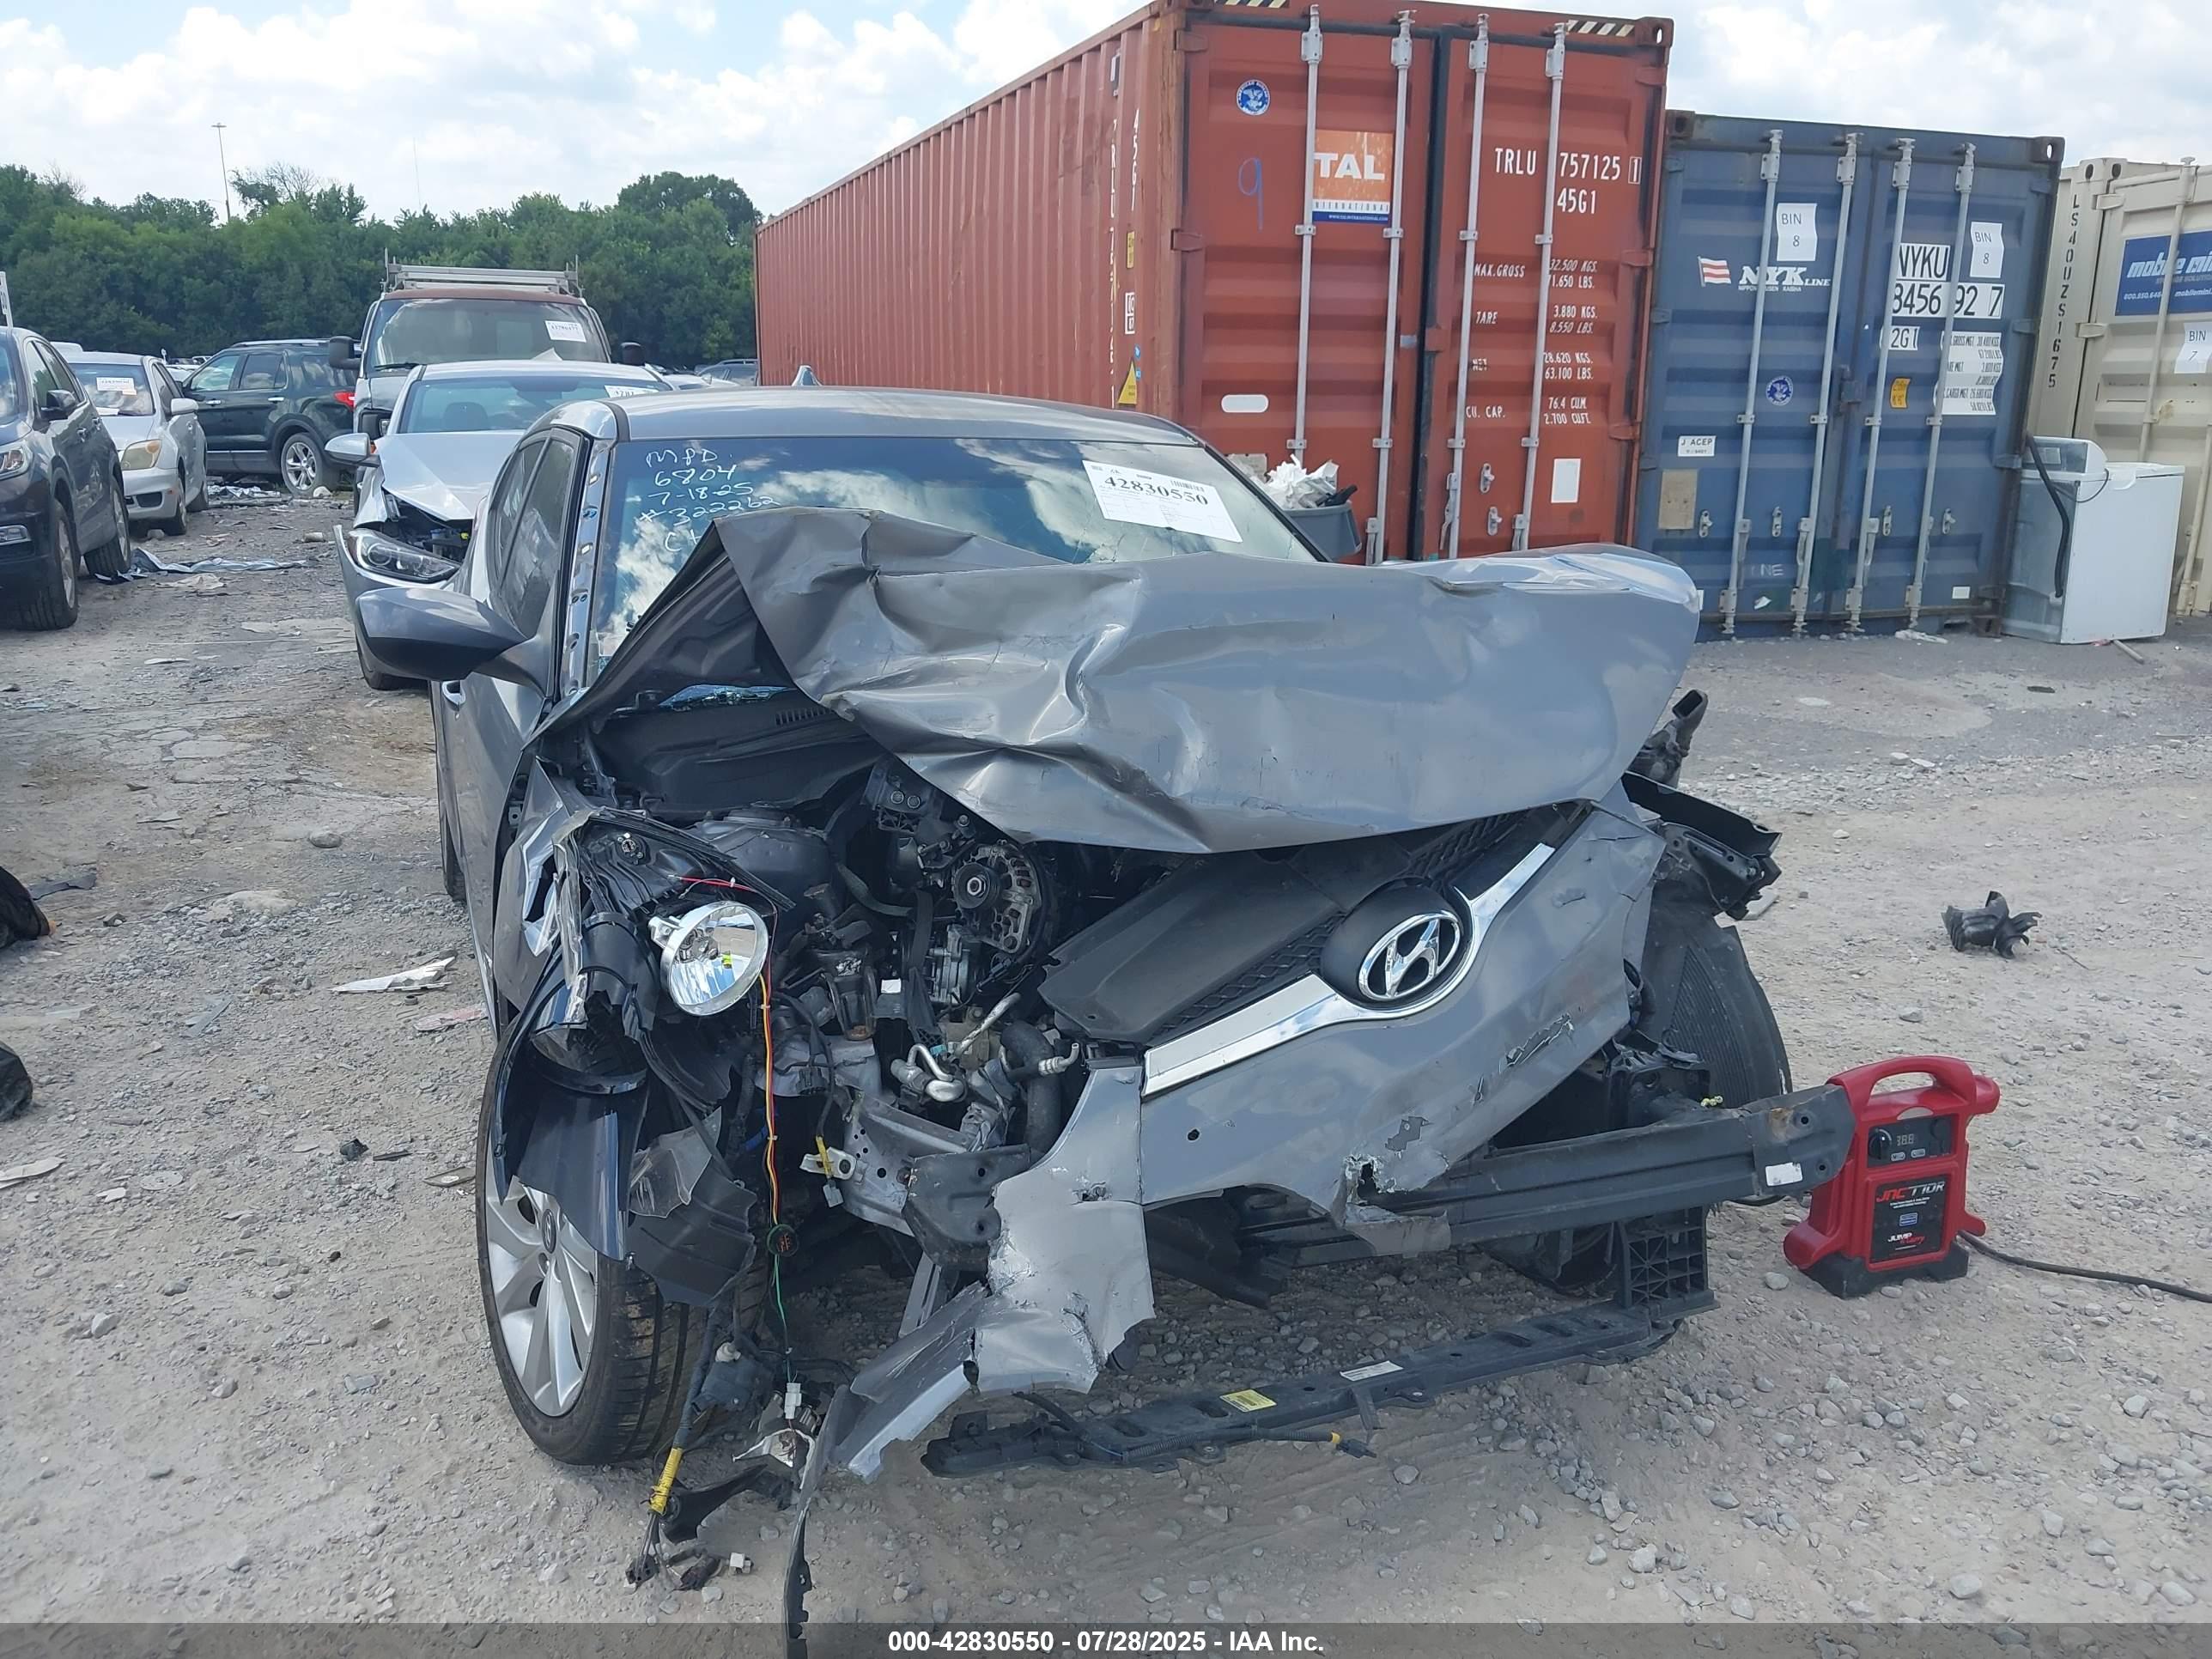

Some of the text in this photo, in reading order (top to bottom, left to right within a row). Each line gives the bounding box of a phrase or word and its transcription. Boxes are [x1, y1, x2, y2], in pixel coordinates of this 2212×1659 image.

[1314, 152, 1385, 180] TAL
[1495, 148, 1536, 175] TRLU
[1559, 152, 1620, 180] 757125
[1557, 187, 1595, 214] 45G1
[1781, 213, 1802, 225] BIN
[1792, 234, 1800, 246] 8
[1975, 231, 1992, 243] BIN
[1983, 252, 1990, 264] 8
[1739, 265, 1831, 287] NYK LINE
[1989, 286, 2003, 317] 7
[1476, 310, 1498, 325] TARE
[2189, 330, 2207, 342] BIN
[2189, 350, 2198, 361] 7
[1466, 406, 1481, 419] CU.
[1486, 405, 1506, 419] CAP.
[1690, 438, 1712, 447] ACEP
[646, 448, 718, 468] MPD
[654, 465, 737, 487] 6804
[1104, 476, 1209, 505] 42830550
[1887, 1232, 1913, 1243] JUMP
